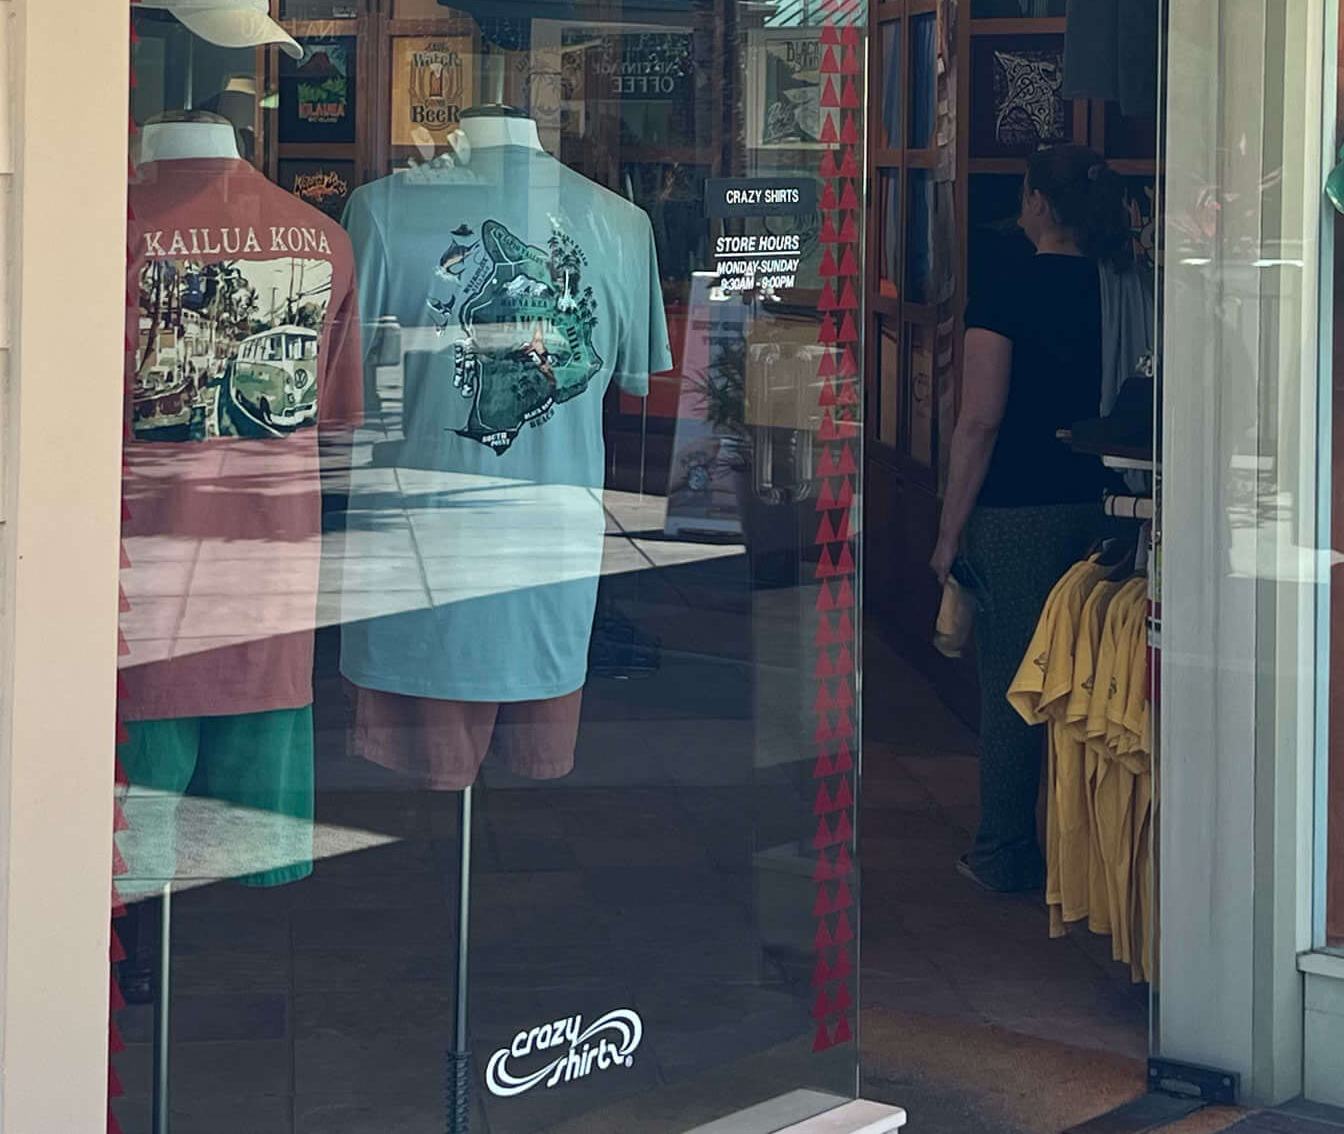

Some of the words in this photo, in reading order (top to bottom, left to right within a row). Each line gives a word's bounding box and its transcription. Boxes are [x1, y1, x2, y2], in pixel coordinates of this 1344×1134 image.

[726, 190, 762, 204] CRAZY
[764, 189, 800, 203] SHIRTS
[144, 226, 262, 256] KAILUA
[269, 226, 332, 255] KONA
[715, 236, 757, 253] STORE
[758, 235, 801, 251] HOURS
[716, 259, 800, 276] MONDAY-SUNDAY
[511, 1015, 582, 1058] crazy
[547, 1039, 625, 1088] shirts
